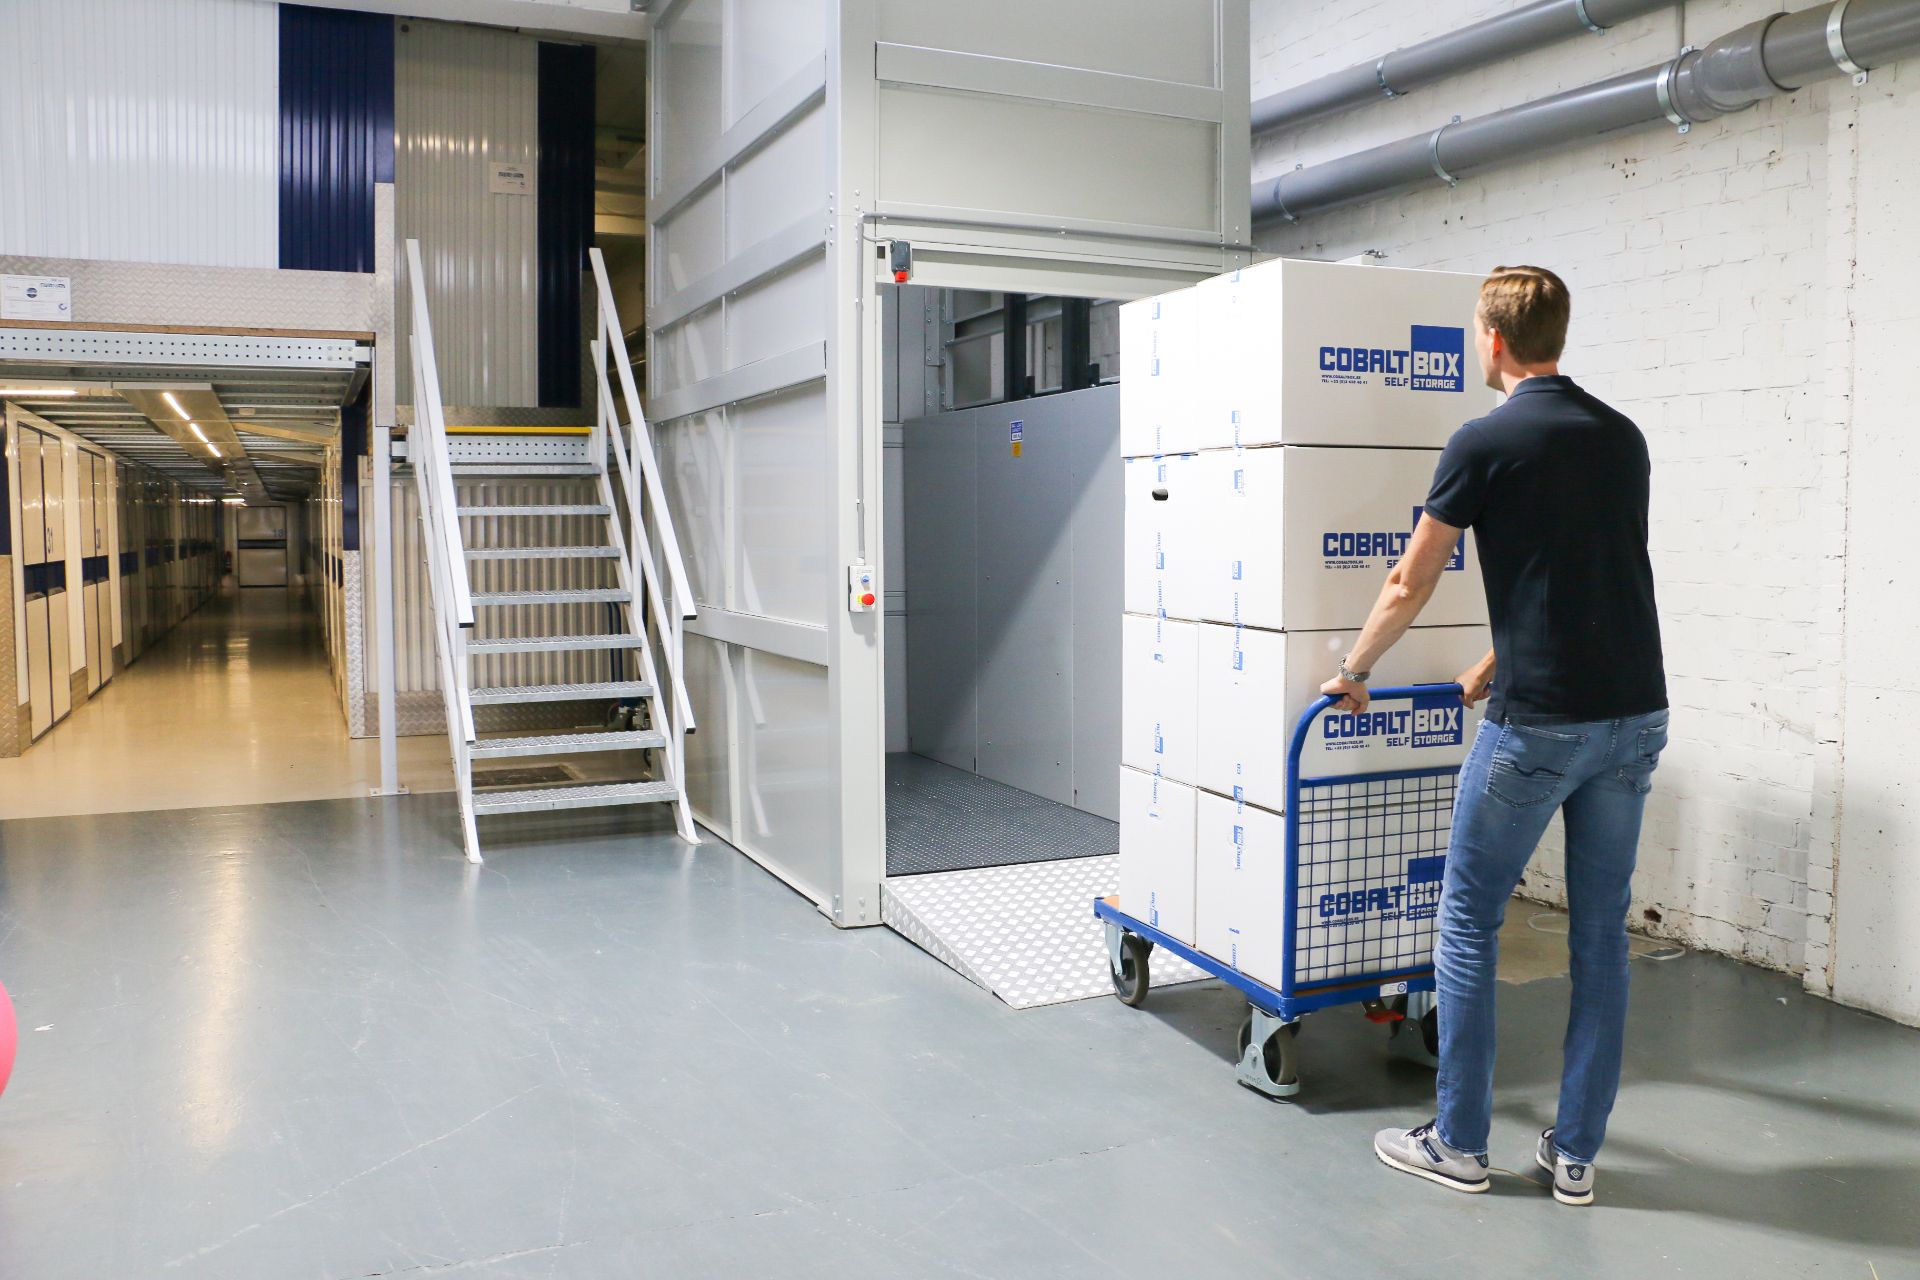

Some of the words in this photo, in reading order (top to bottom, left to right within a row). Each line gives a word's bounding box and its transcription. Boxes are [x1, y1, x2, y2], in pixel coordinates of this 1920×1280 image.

[1319, 346, 1410, 374] COBALT
[1413, 351, 1460, 377] BOX
[1384, 377, 1409, 387] SELF
[1413, 378, 1456, 389] STORAGE
[1322, 532, 1412, 557] COBALT
[1386, 559, 1401, 569] SE
[1323, 710, 1411, 739] COBALT
[1414, 707, 1459, 733] BOX
[1386, 736, 1411, 747] SELF
[1413, 733, 1455, 746] STORAGE
[1319, 884, 1407, 918] COBALT
[1409, 880, 1441, 908] BO
